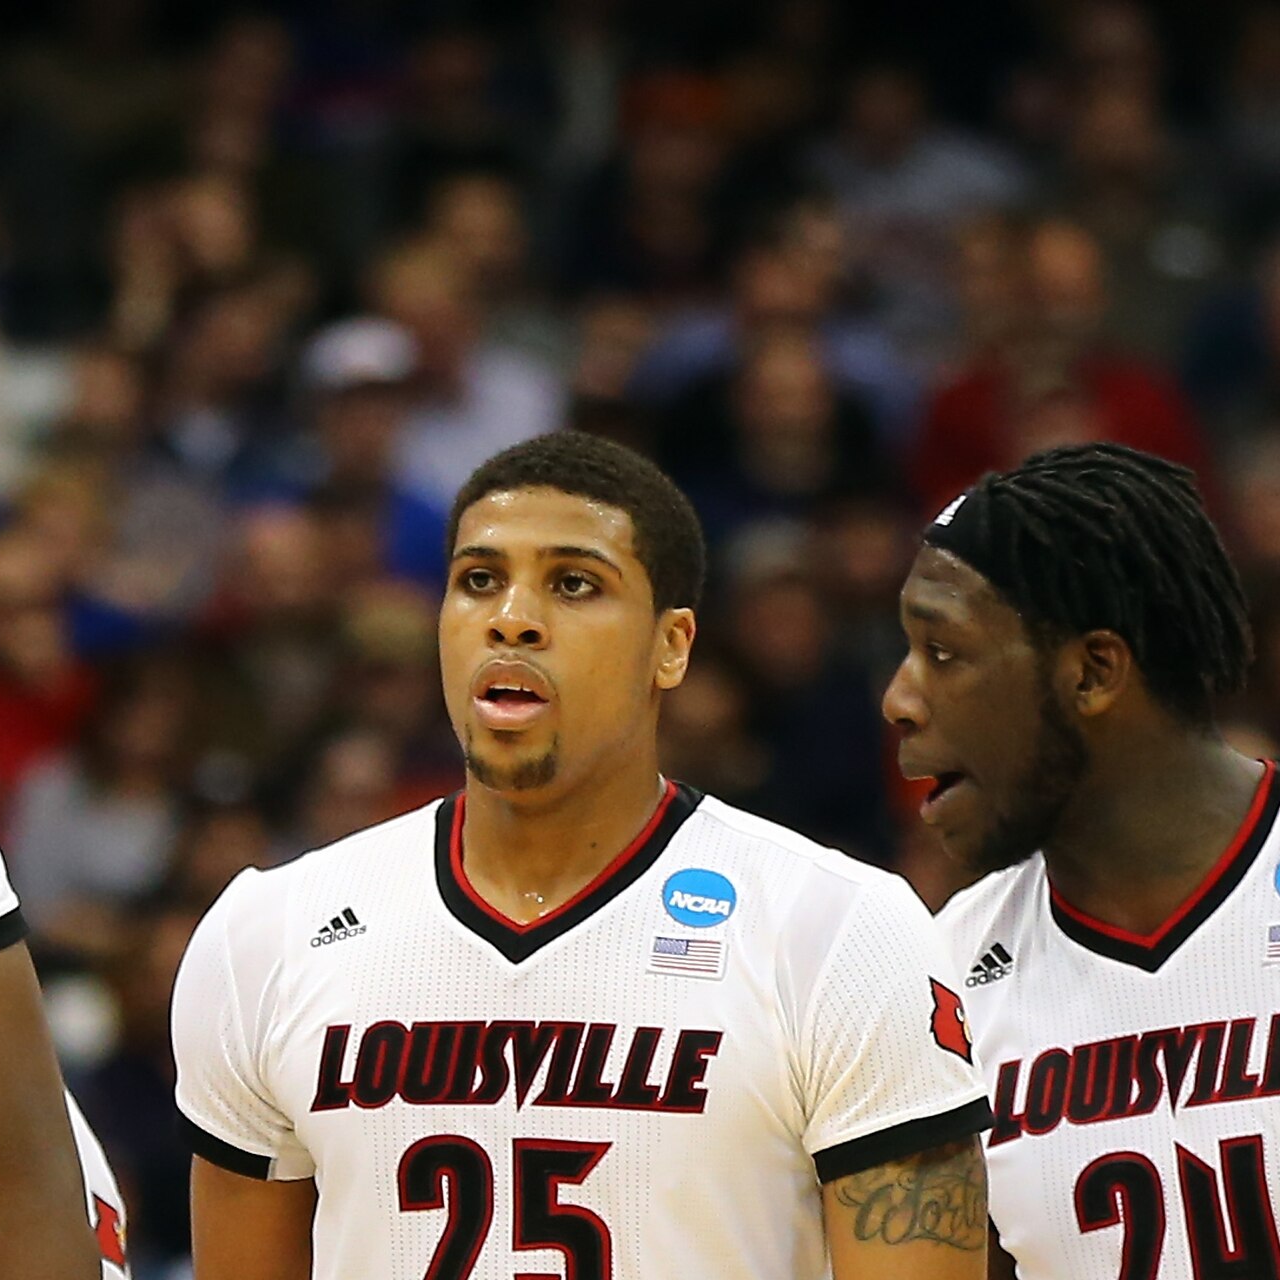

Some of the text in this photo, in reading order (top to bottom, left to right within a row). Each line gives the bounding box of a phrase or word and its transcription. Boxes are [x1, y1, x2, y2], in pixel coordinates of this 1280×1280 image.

[669, 890, 731, 917] NCAA
[310, 924, 366, 948] adidas
[310, 1019, 723, 1113] LOUISVILLE
